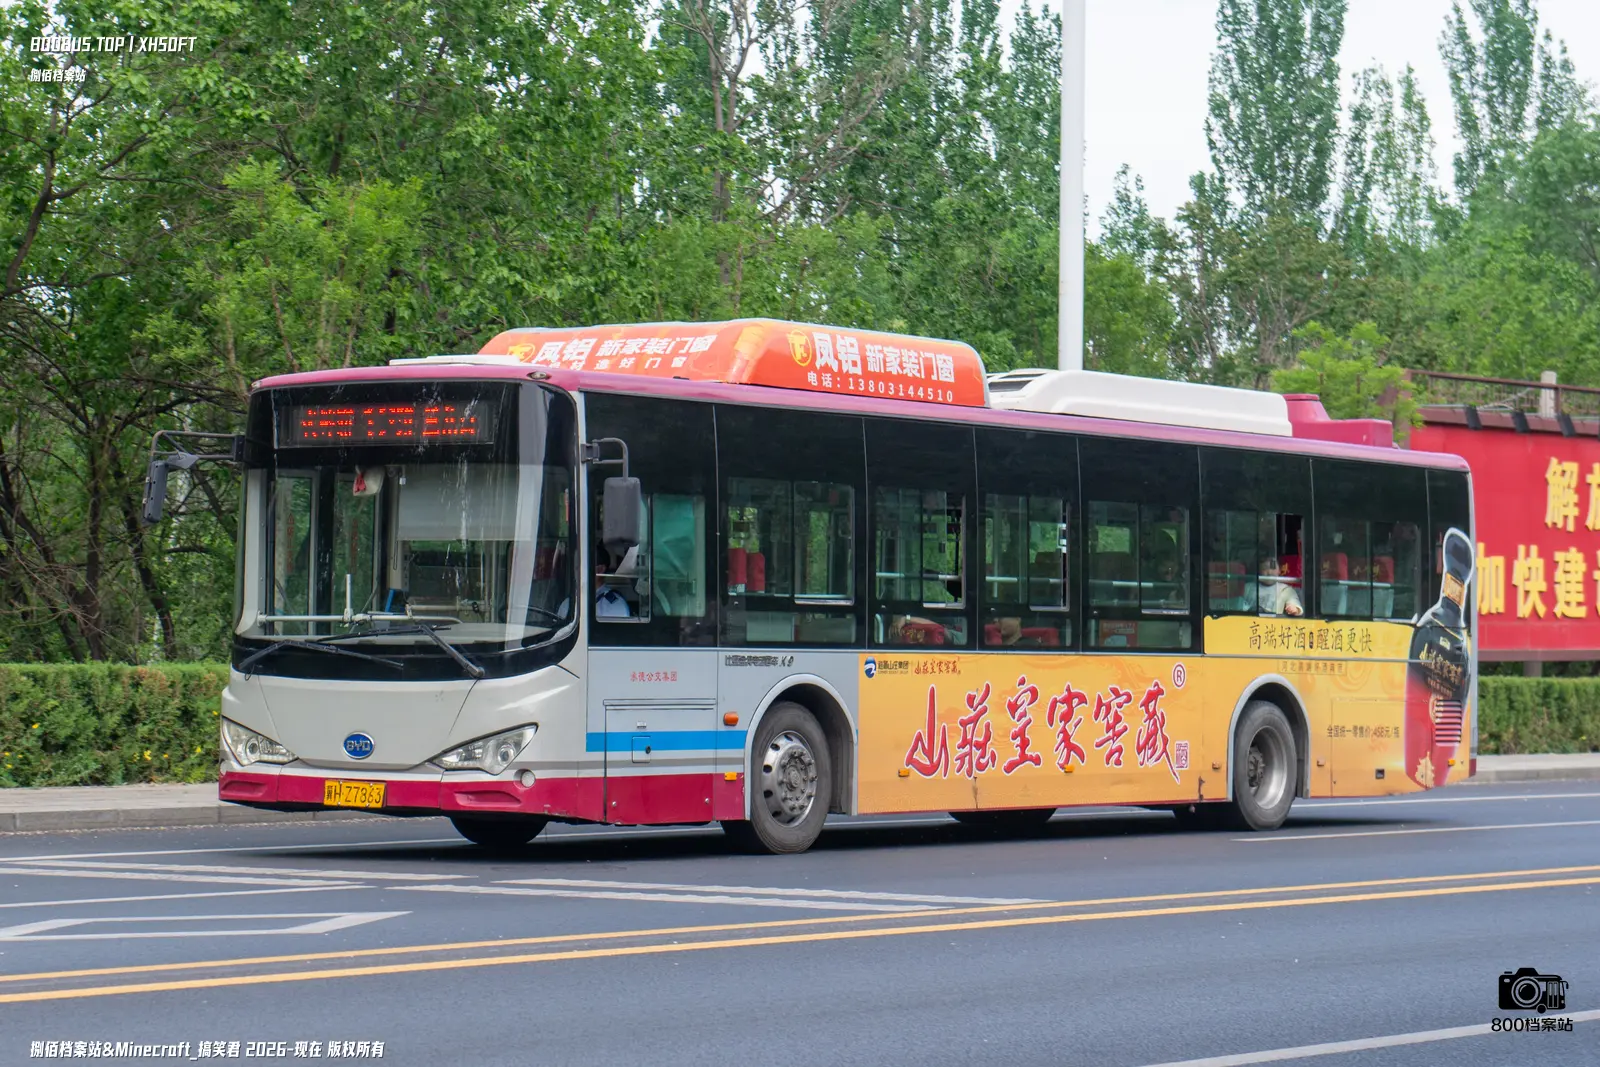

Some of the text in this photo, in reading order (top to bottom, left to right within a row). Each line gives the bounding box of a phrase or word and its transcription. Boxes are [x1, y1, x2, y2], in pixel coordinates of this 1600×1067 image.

[532, 334, 717, 364] 凤铝 新家装门窗
[812, 331, 955, 383] 凤铝 新家装门窗
[1476, 541, 1600, 619] 加快建
[346, 740, 371, 751] BYD
